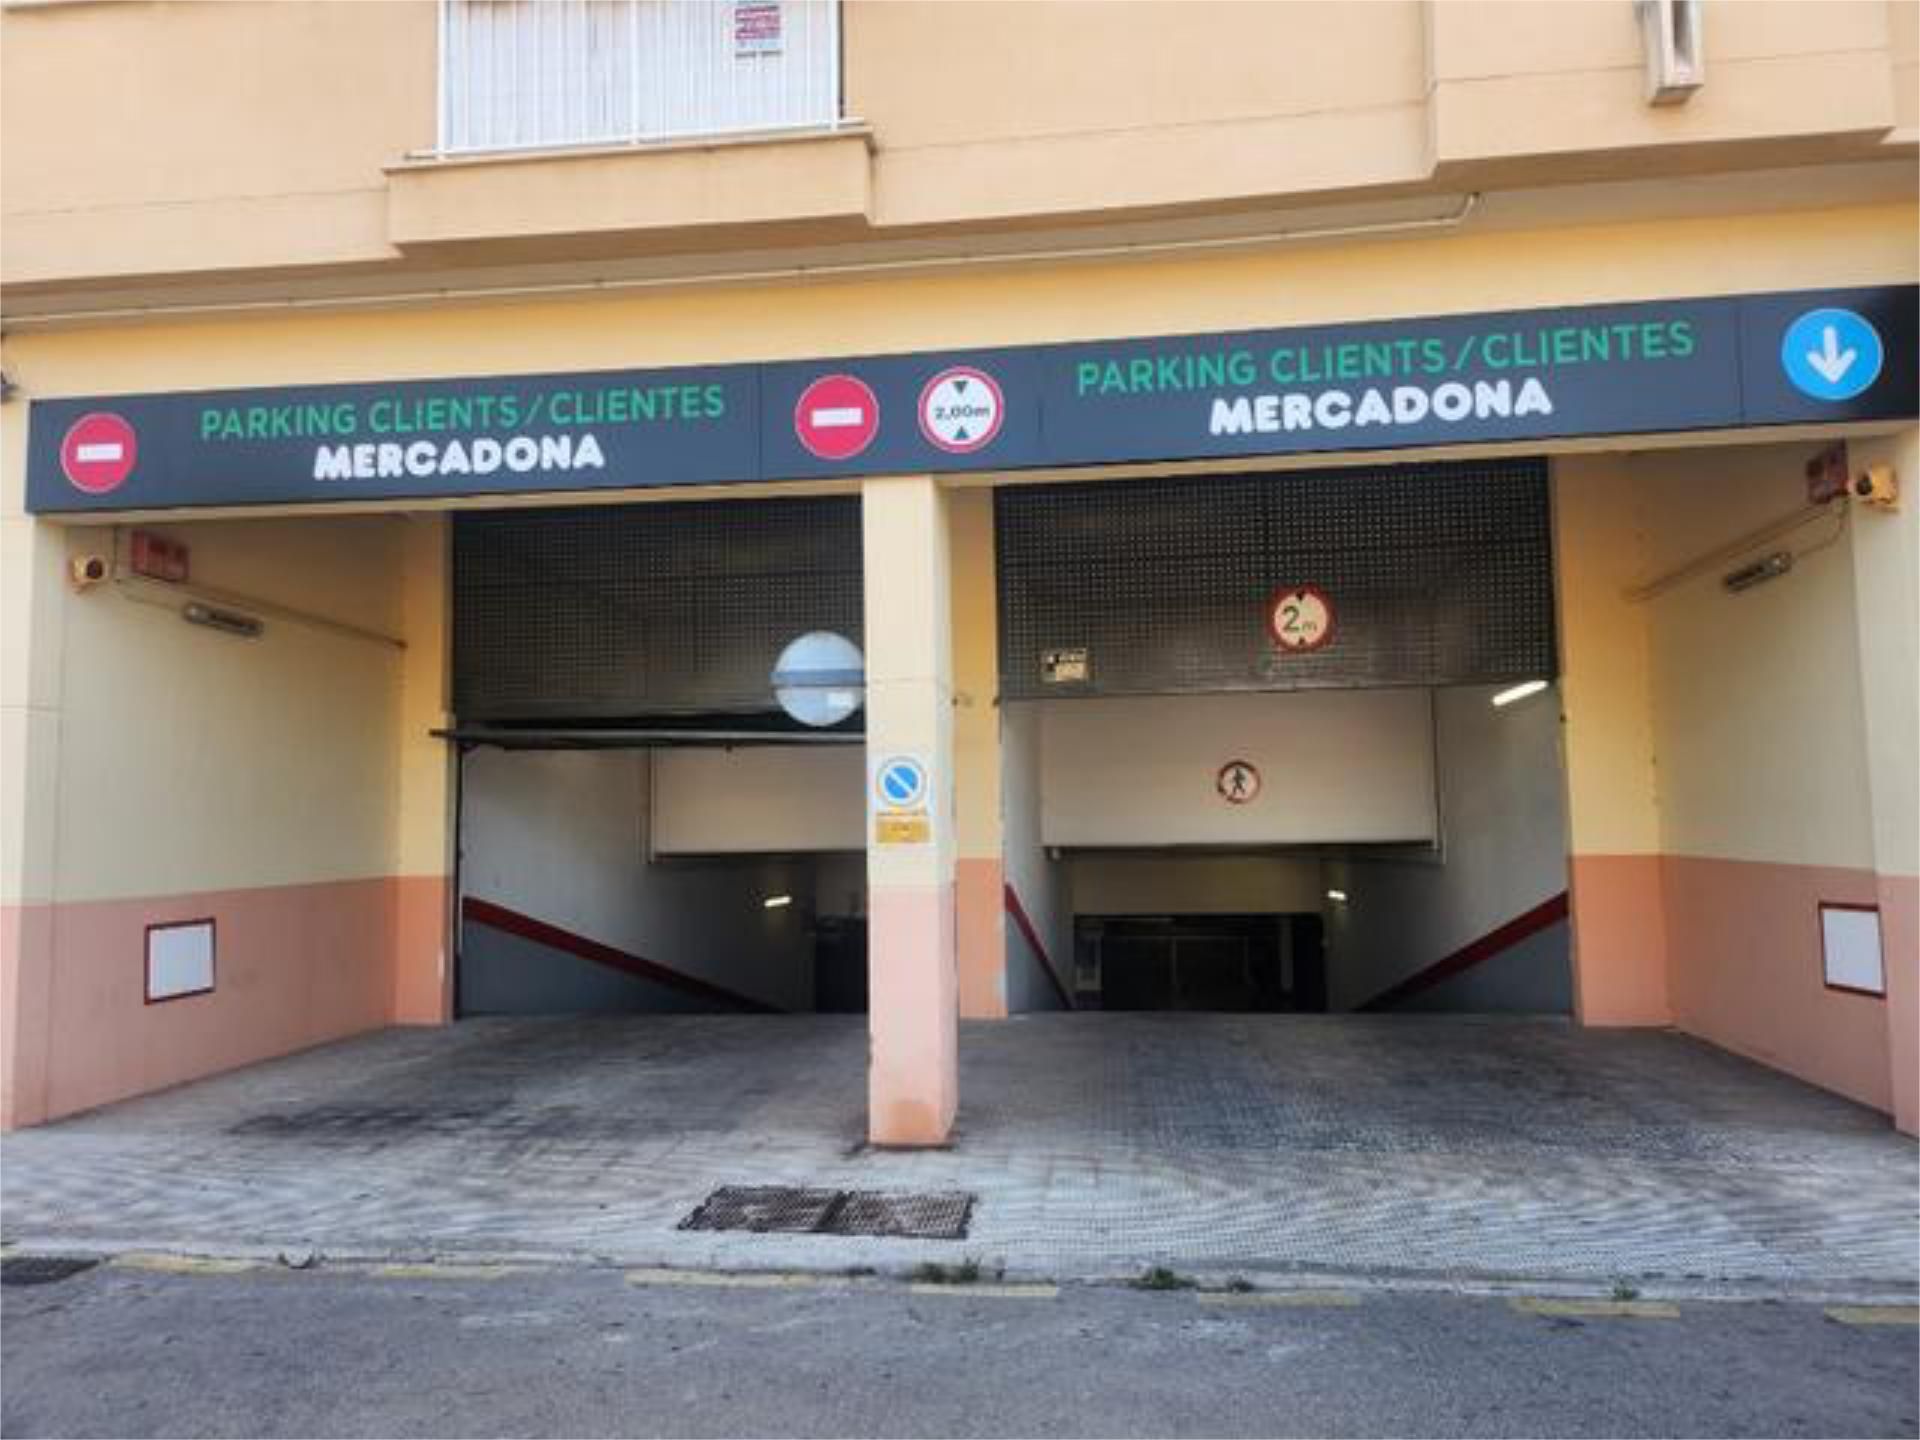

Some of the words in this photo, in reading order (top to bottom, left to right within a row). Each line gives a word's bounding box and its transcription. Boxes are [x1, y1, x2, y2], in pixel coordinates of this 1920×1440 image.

[1078, 351, 1257, 396] PARKING
[201, 404, 356, 441] PARKING
[1208, 376, 1553, 436] MERCADONA
[313, 433, 605, 480] MERCADONA
